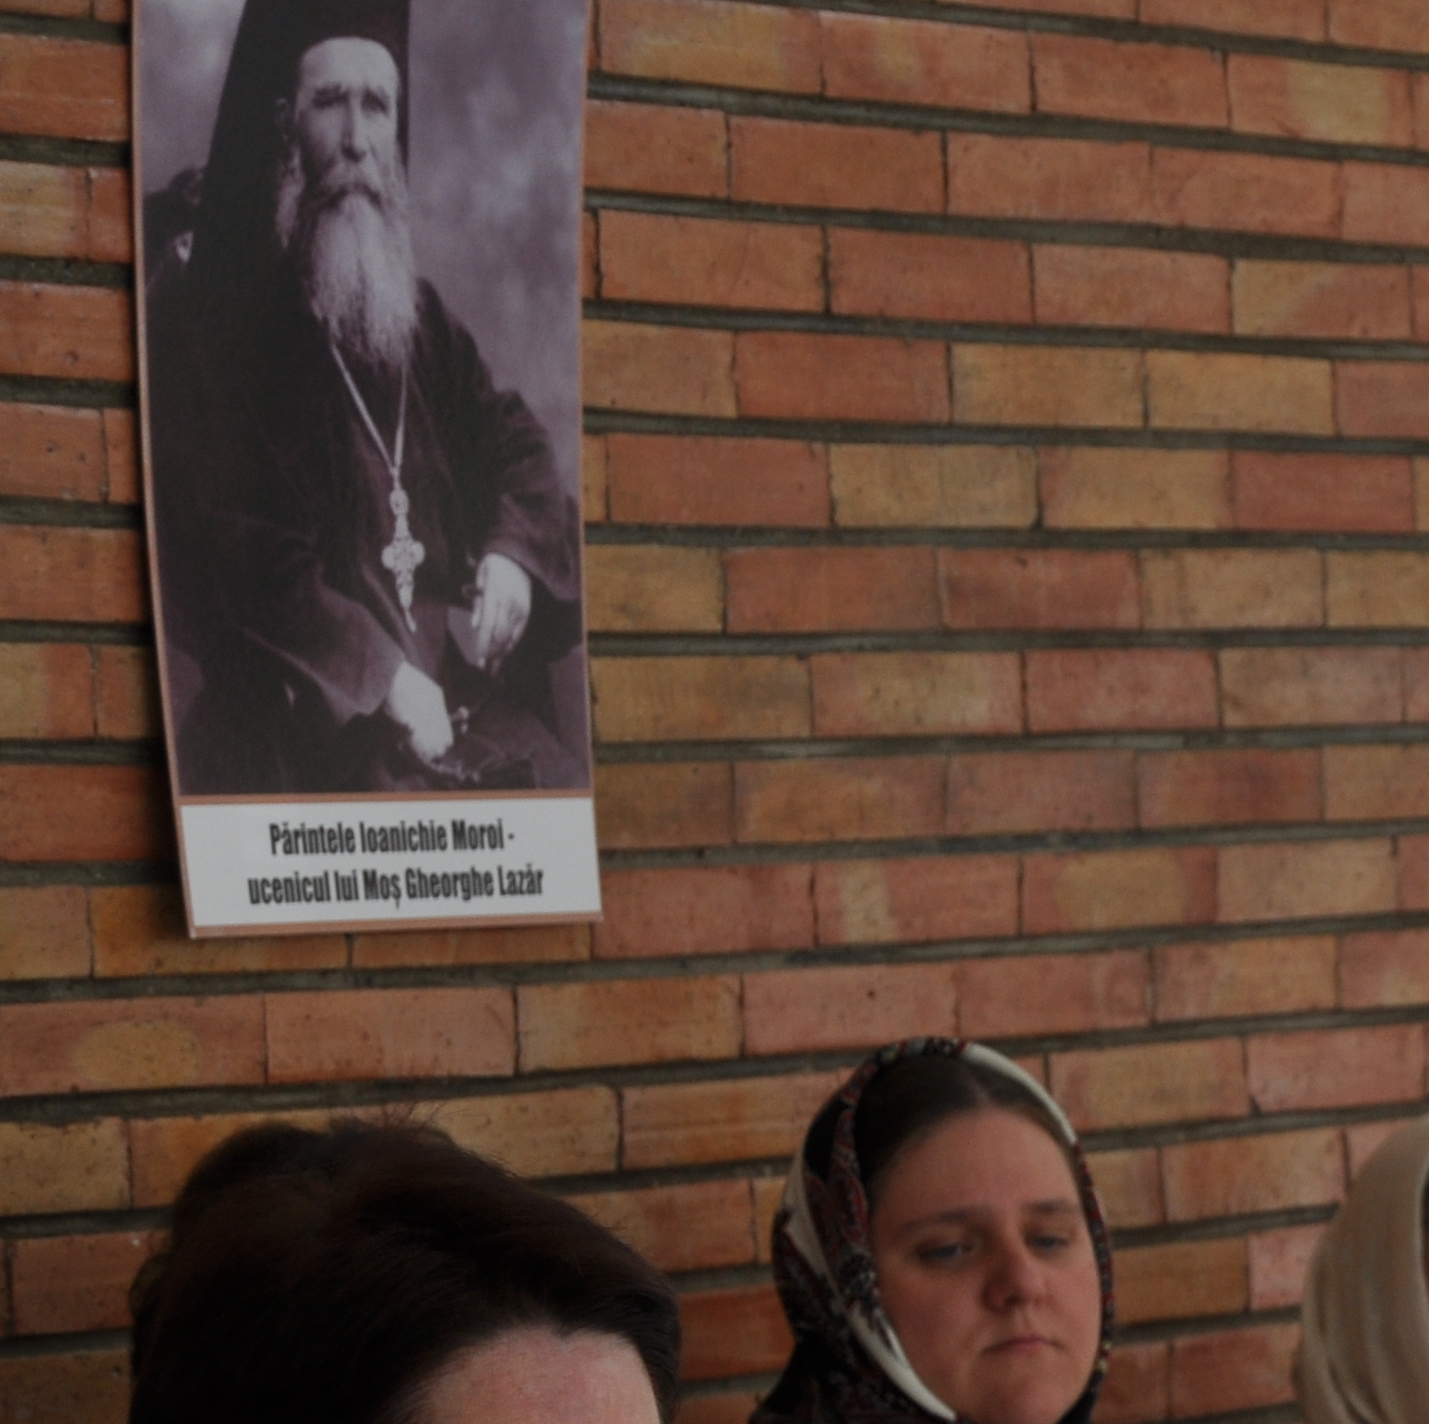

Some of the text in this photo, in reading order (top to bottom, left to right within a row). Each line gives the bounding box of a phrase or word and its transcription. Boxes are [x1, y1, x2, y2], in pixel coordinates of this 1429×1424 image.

[269, 821, 356, 855] Părintele
[359, 820, 448, 853] Ioanichie
[451, 817, 504, 851] Moroi
[247, 870, 331, 905] ucenicul
[333, 869, 359, 901] lui
[362, 867, 401, 909] Moș
[405, 866, 494, 902] Gheorghe
